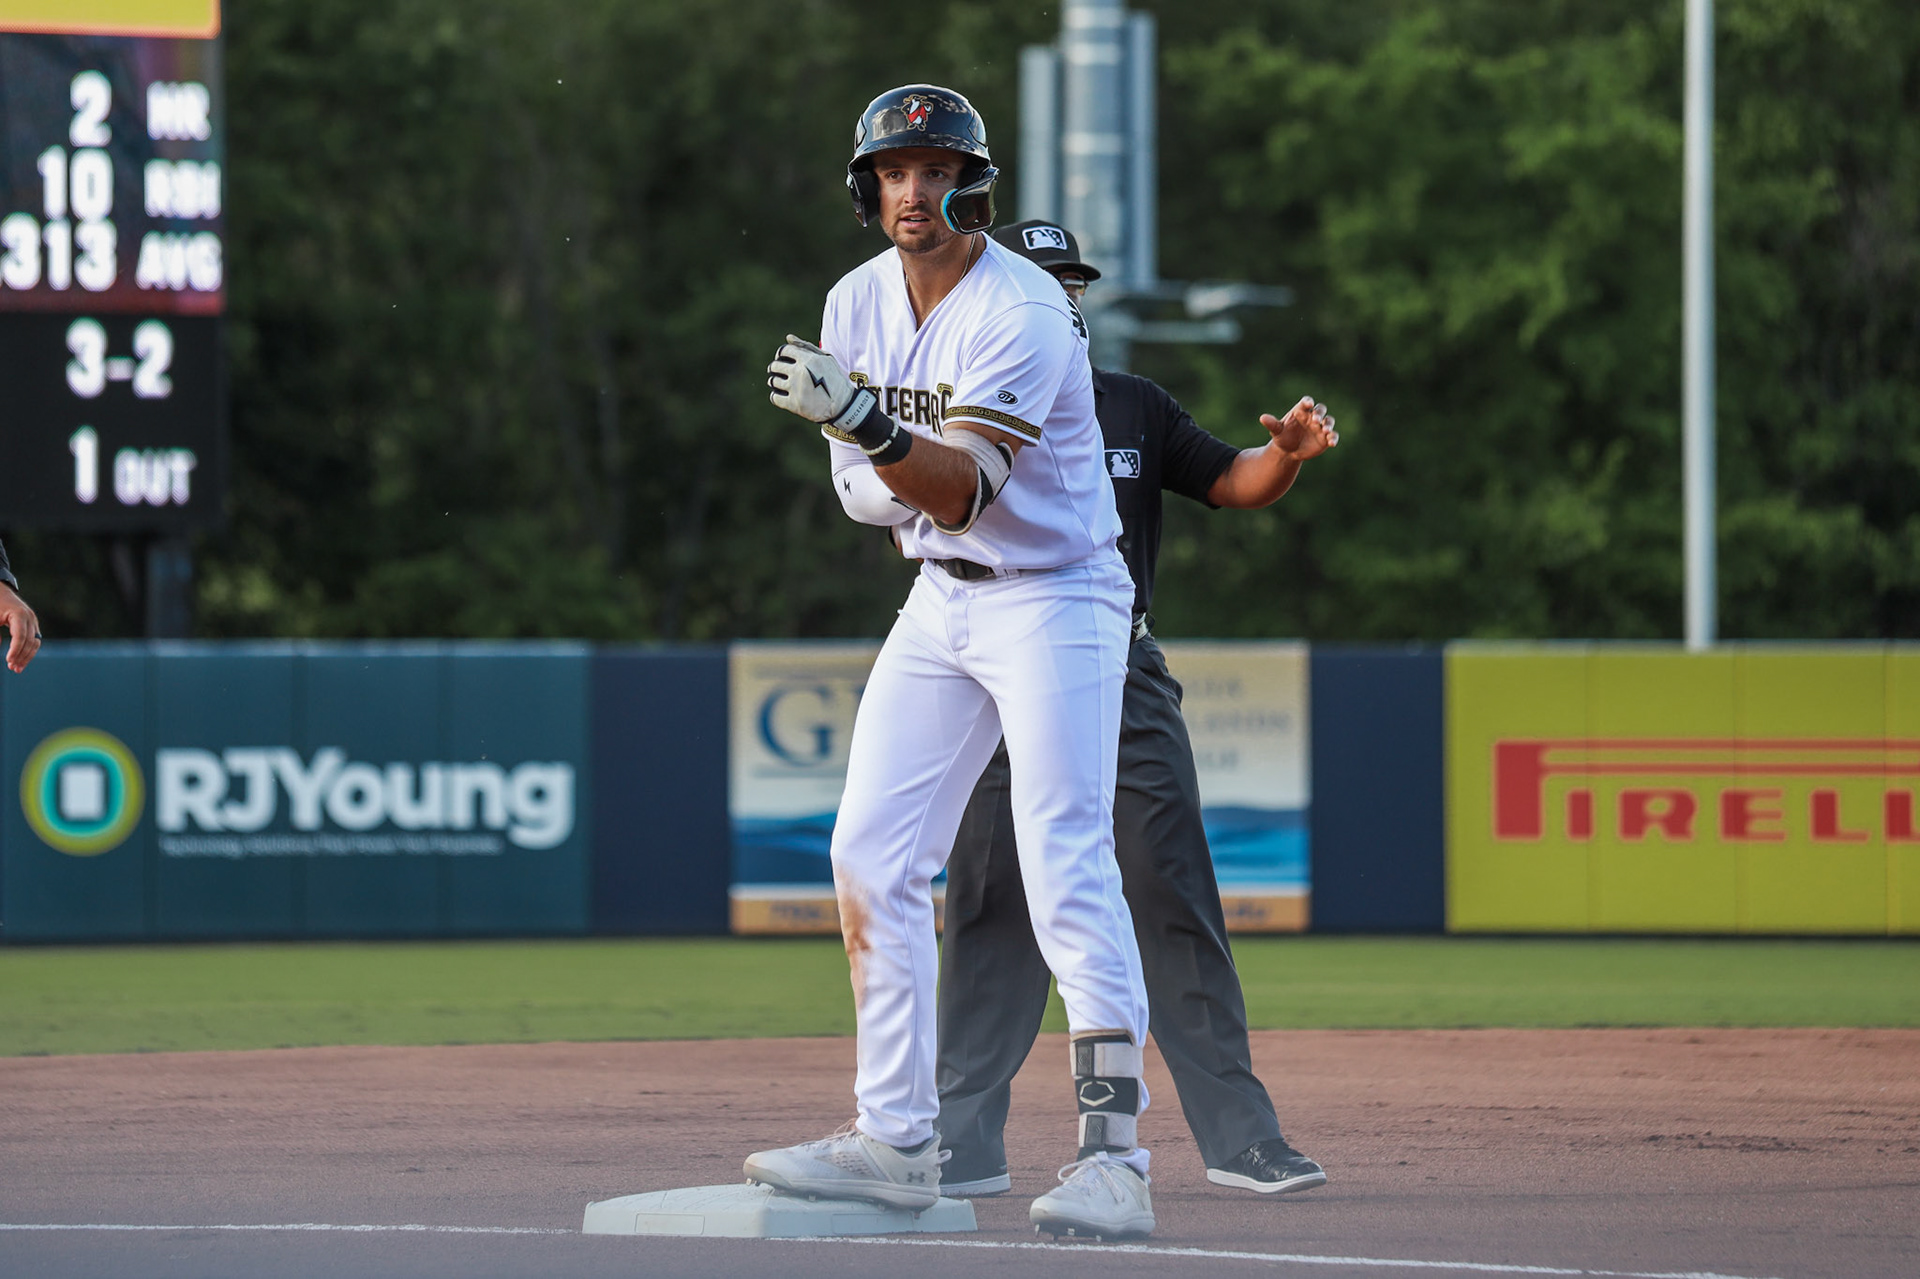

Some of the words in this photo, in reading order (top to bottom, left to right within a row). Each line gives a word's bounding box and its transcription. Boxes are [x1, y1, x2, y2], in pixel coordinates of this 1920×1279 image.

[70, 71, 111, 146] 2
[38, 145, 113, 220] 10
[0, 213, 117, 291] 313
[66, 318, 173, 398] 3-2
[70, 425, 98, 503] 1
[114, 448, 195, 504] OUT
[157, 747, 574, 849] RJYoung
